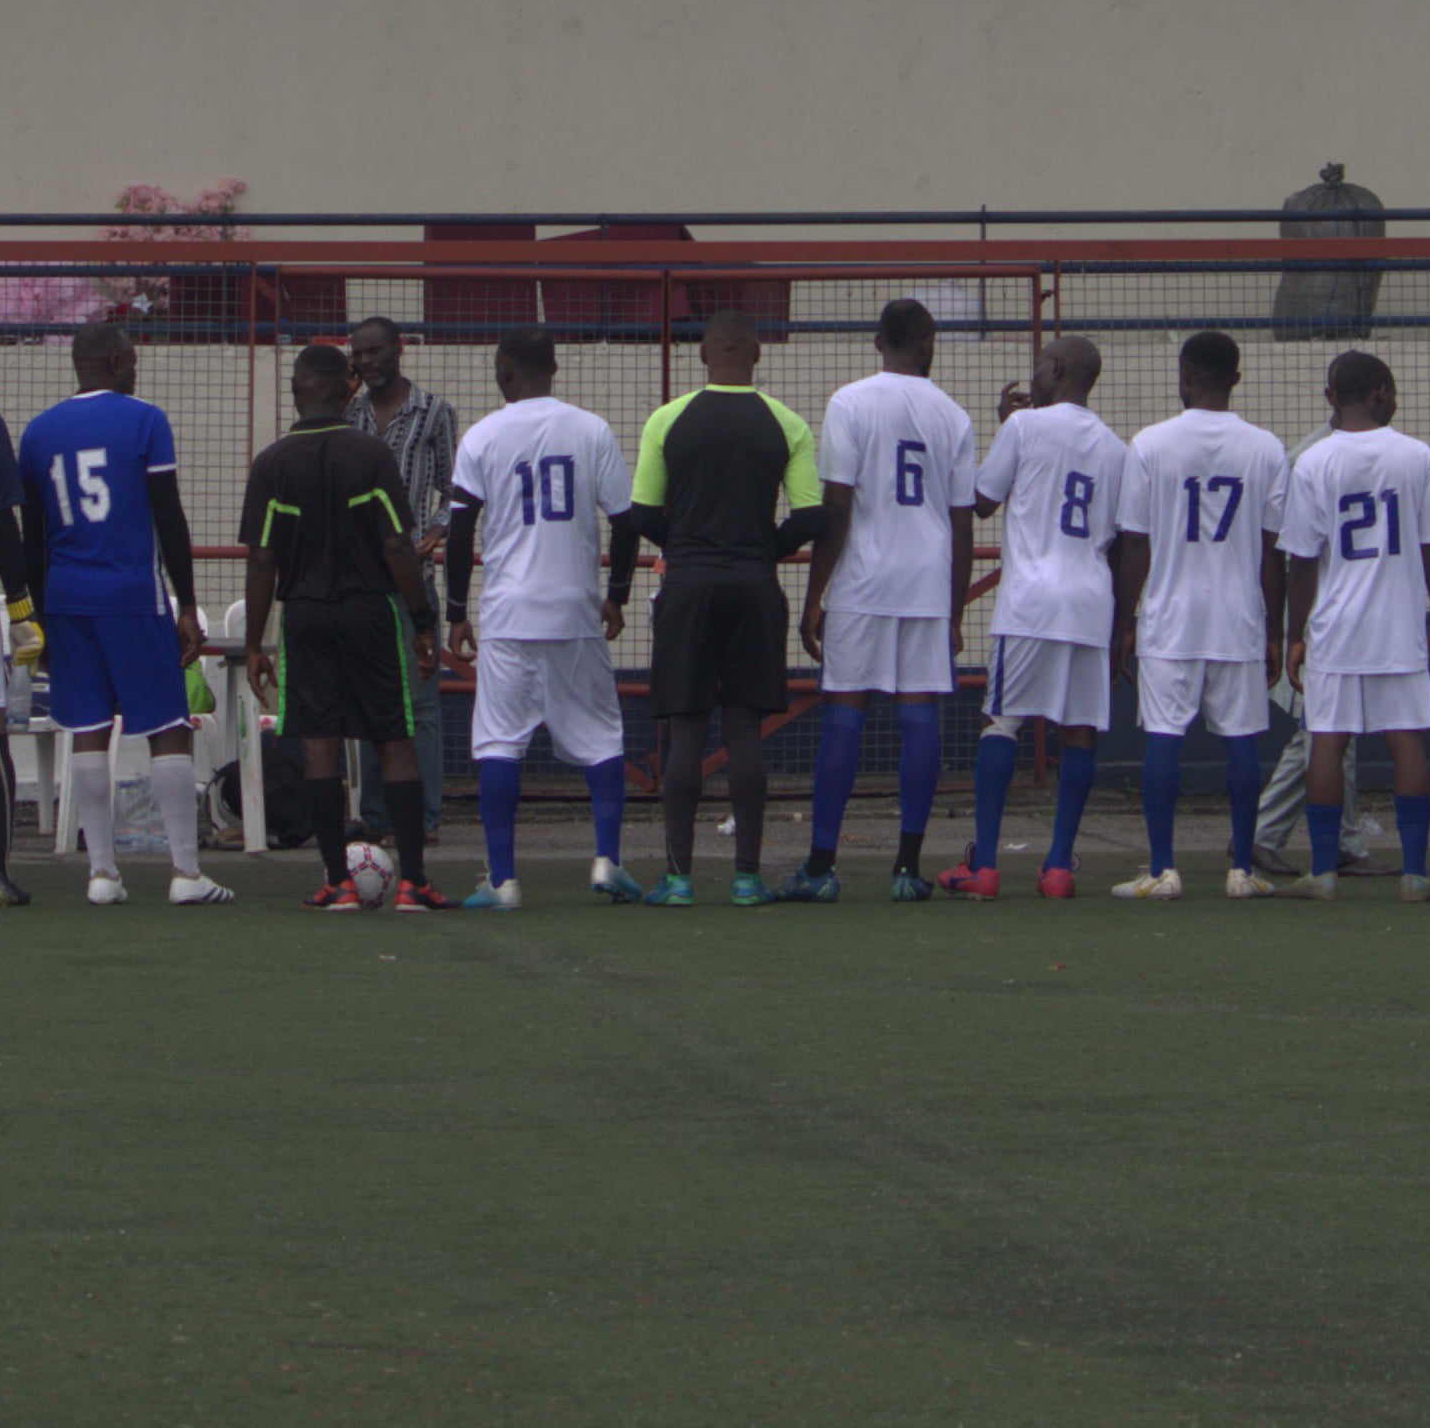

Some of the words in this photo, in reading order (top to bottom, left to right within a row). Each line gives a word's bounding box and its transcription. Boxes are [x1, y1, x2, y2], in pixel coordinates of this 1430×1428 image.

[51, 448, 110, 525] 15
[515, 455, 575, 525] 10
[896, 440, 926, 506] 6
[1061, 471, 1094, 539] 8
[1184, 476, 1243, 542] 17
[1339, 489, 1400, 560] 21
